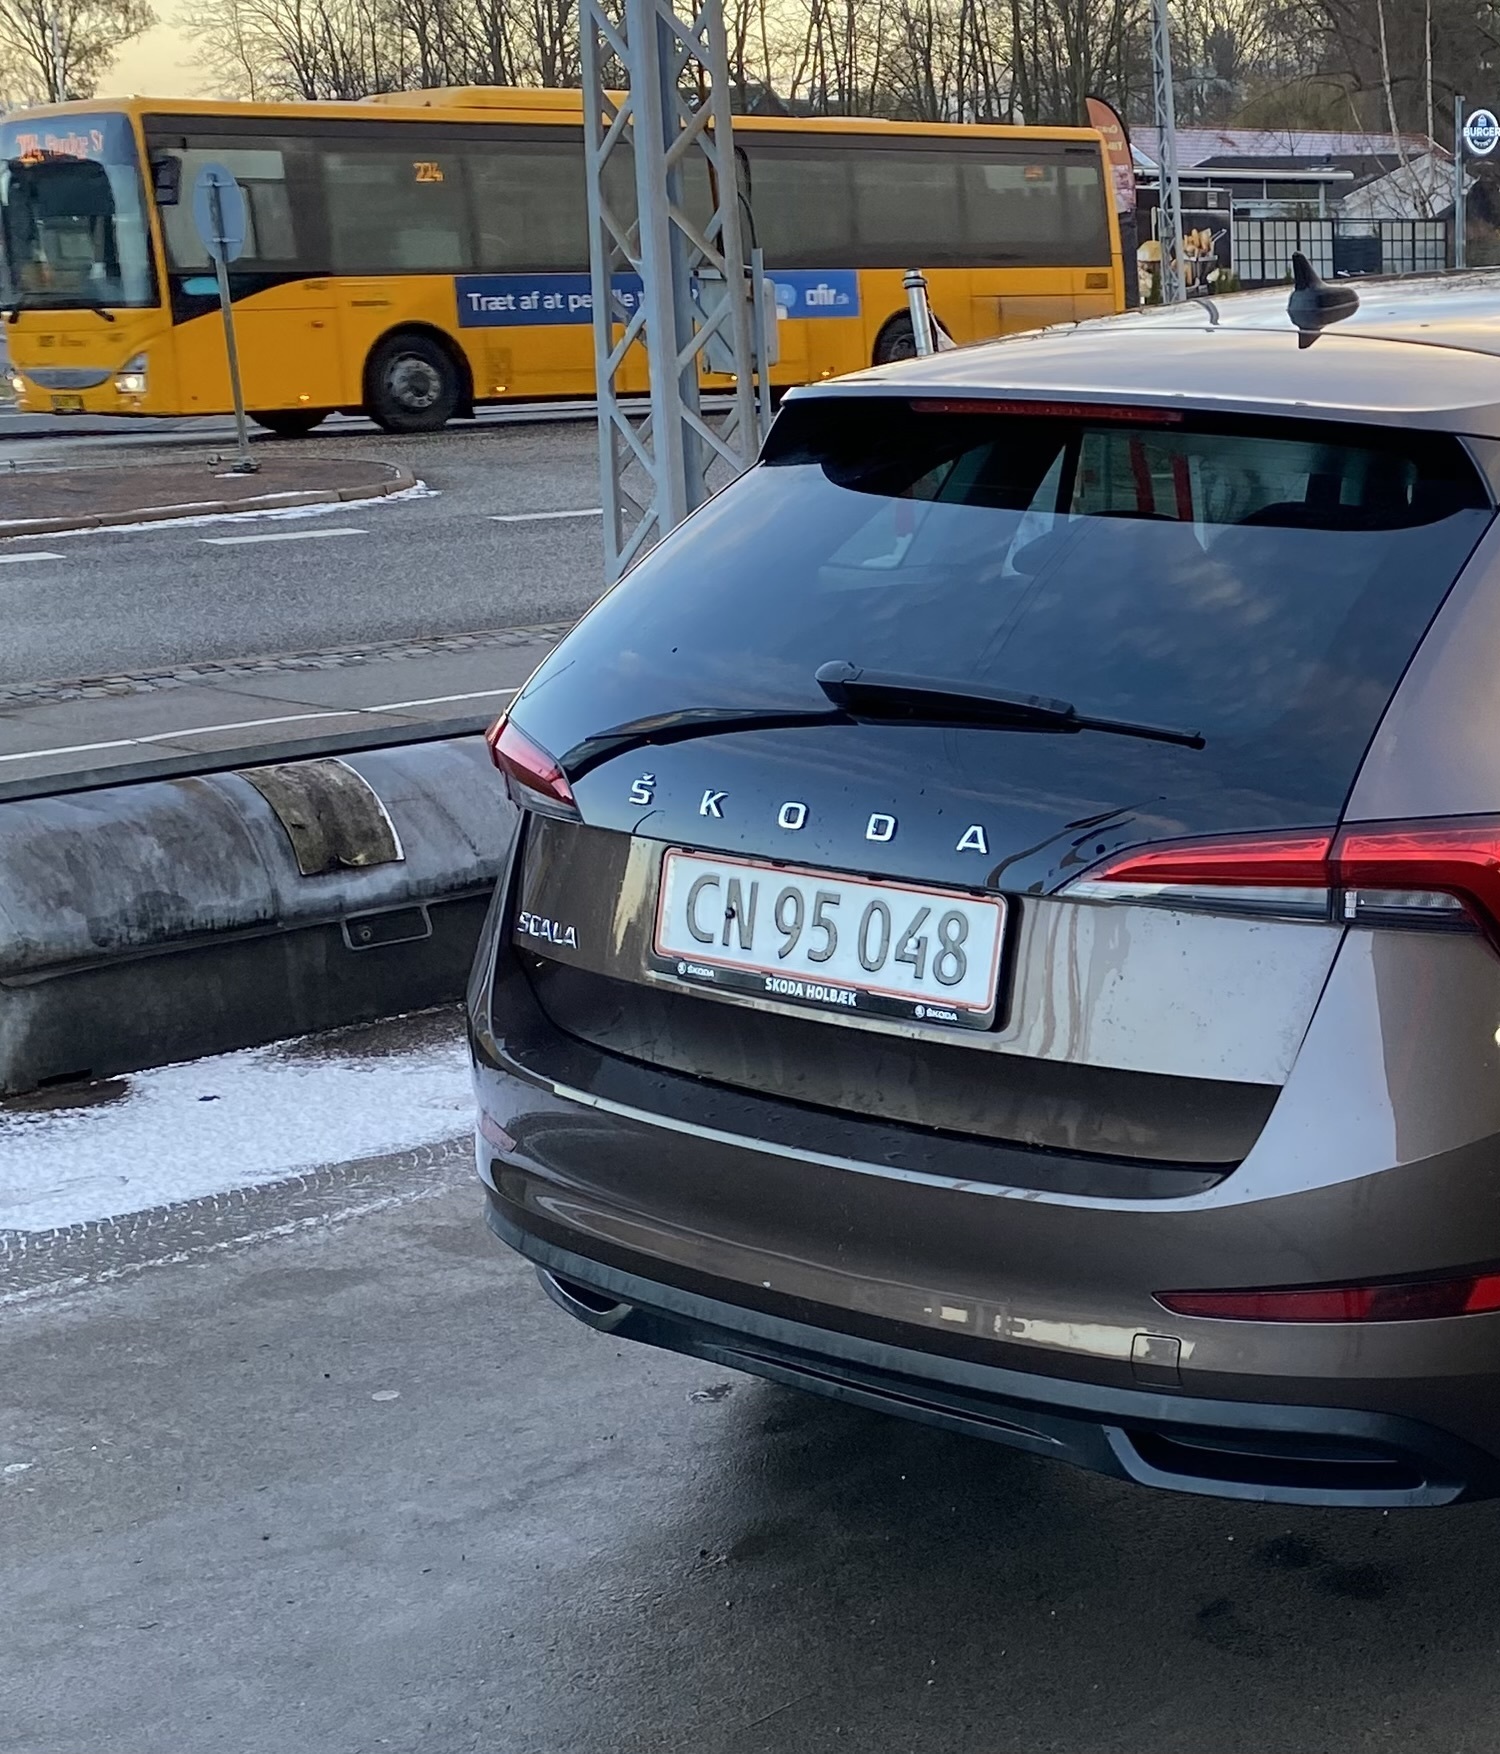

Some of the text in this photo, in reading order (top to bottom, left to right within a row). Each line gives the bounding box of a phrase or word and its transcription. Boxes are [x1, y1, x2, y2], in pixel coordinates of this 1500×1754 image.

[1463, 127, 1500, 137] BURGER
[466, 293, 517, 312] Træt
[519, 291, 540, 310] af
[543, 293, 564, 309] at
[568, 289, 635, 313] pele
[628, 773, 989, 854] ŠKODA
[516, 911, 577, 949] SCALA
[685, 874, 970, 986] CN 95 048
[764, 977, 857, 1007] SKODA HOLBÆK
